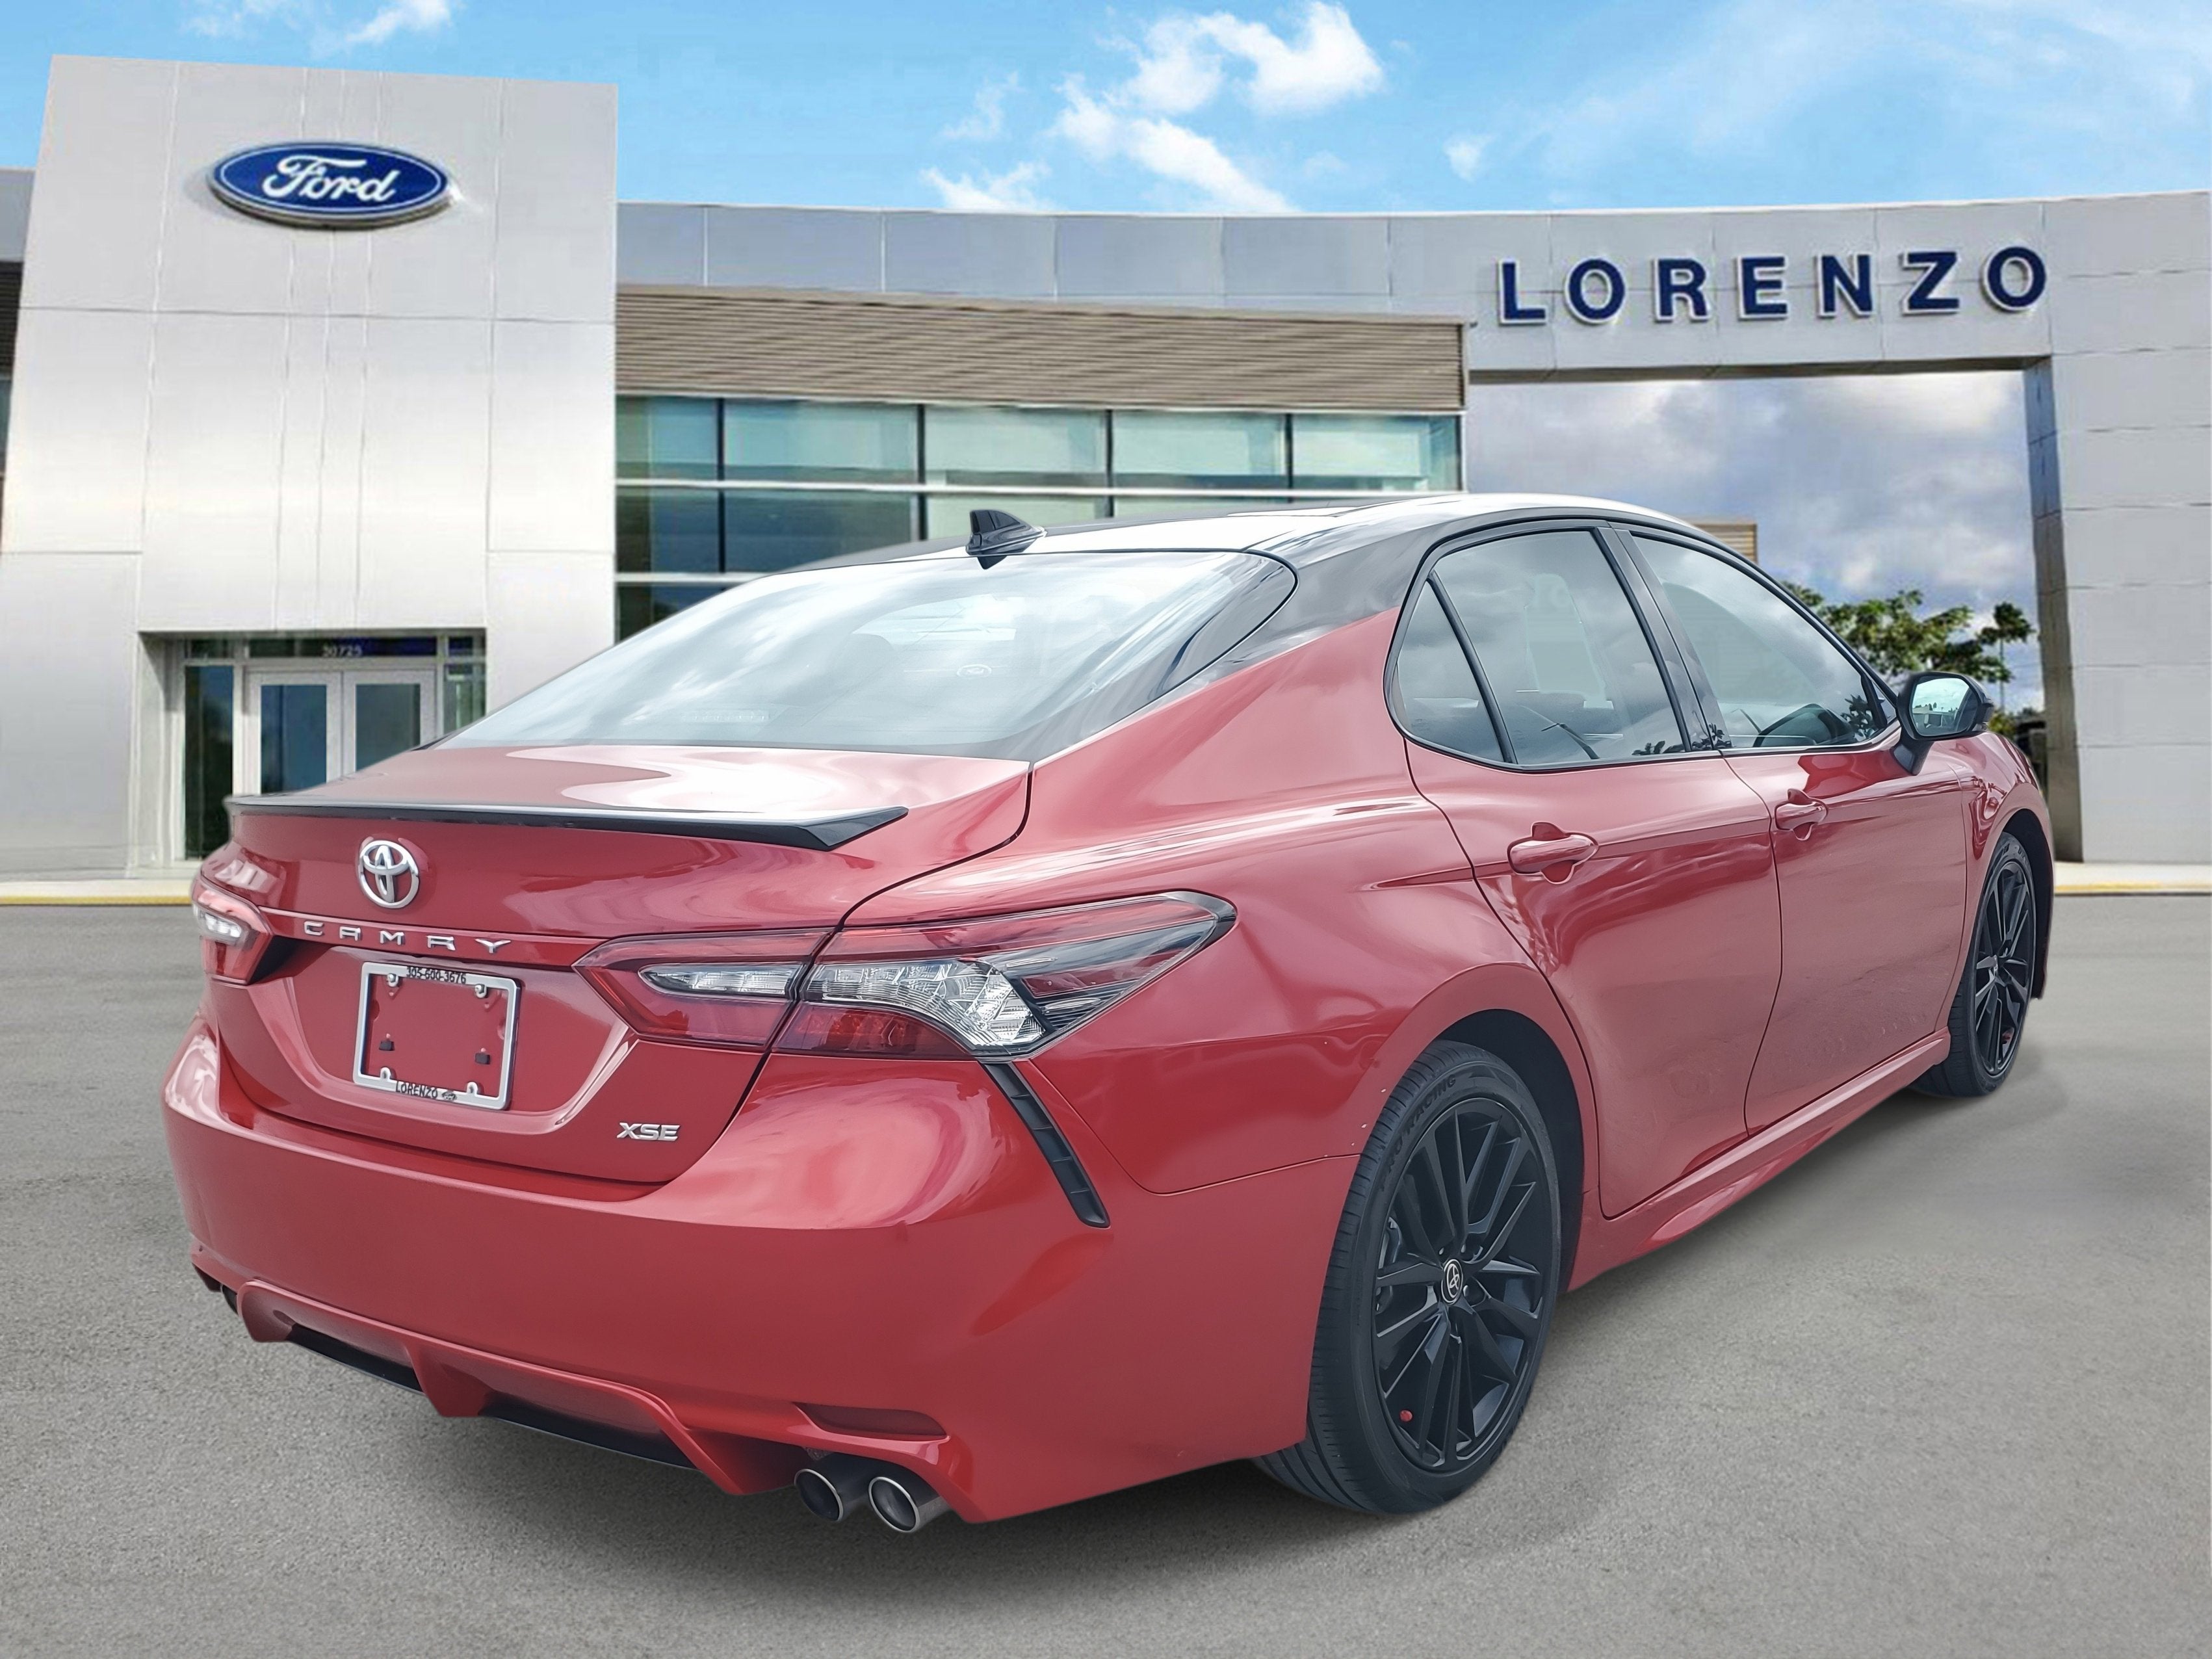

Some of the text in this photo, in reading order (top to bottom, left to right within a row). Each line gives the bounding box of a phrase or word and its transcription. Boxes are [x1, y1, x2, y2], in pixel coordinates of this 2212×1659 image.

[263, 155, 400, 202] Ford
[1500, 246, 2047, 324] LORENZO
[304, 921, 512, 954] CAMRY
[406, 966, 467, 984] 305-600-3676
[396, 1080, 438, 1099] LORENZO
[1403, 1074, 1456, 1136] RACING
[617, 1122, 681, 1142] XSE
